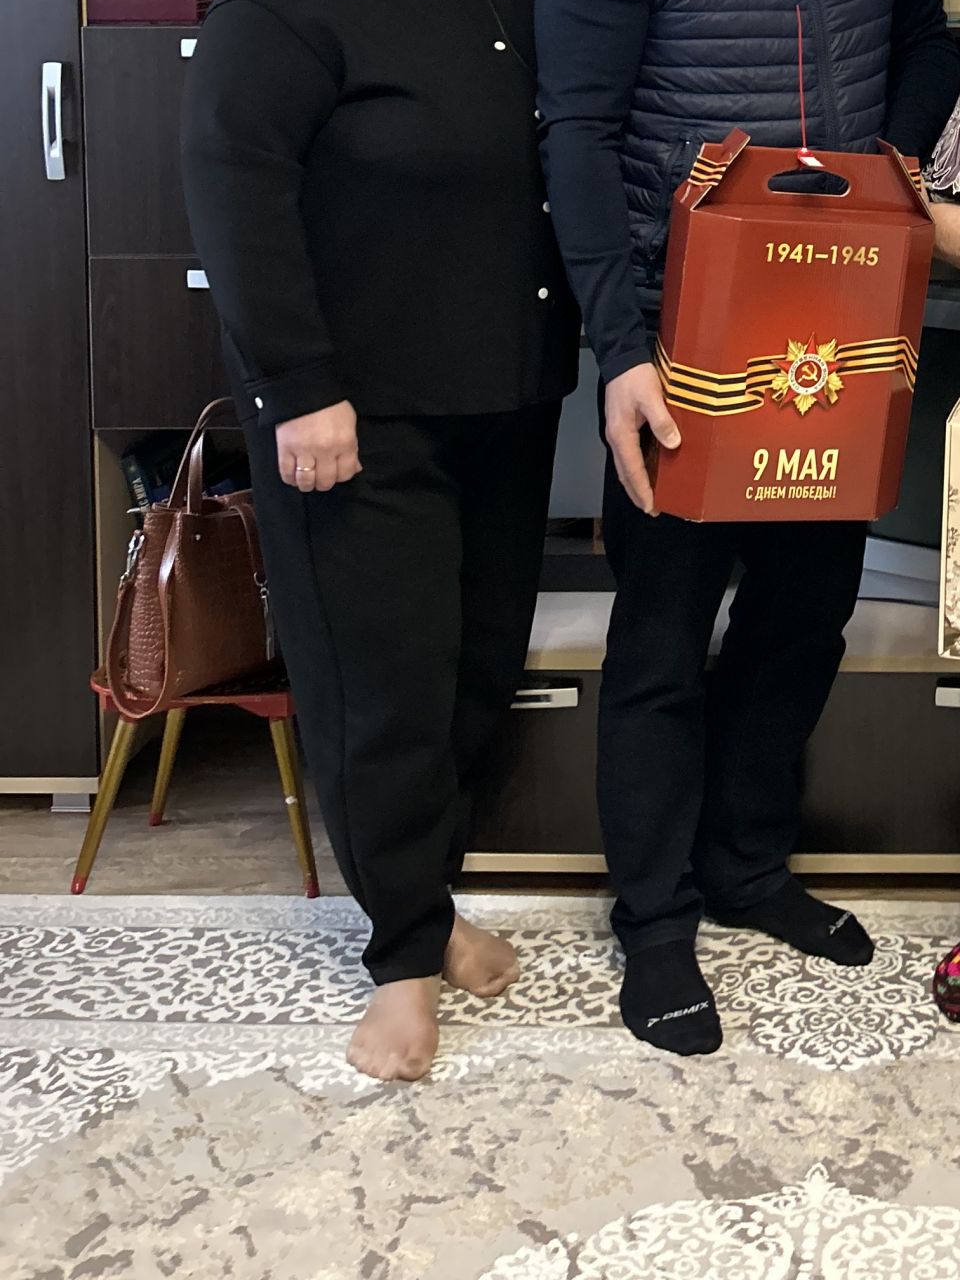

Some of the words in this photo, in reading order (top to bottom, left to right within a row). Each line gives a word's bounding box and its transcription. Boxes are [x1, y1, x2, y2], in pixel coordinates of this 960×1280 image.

[753, 448, 769, 481] 9
[775, 448, 839, 481] МАЯ
[745, 486, 754, 499] С
[754, 486, 787, 501] ДНЕМ
[788, 485, 837, 500] ПОБЕДЫ!
[662, 1001, 709, 1020] DEMIX
